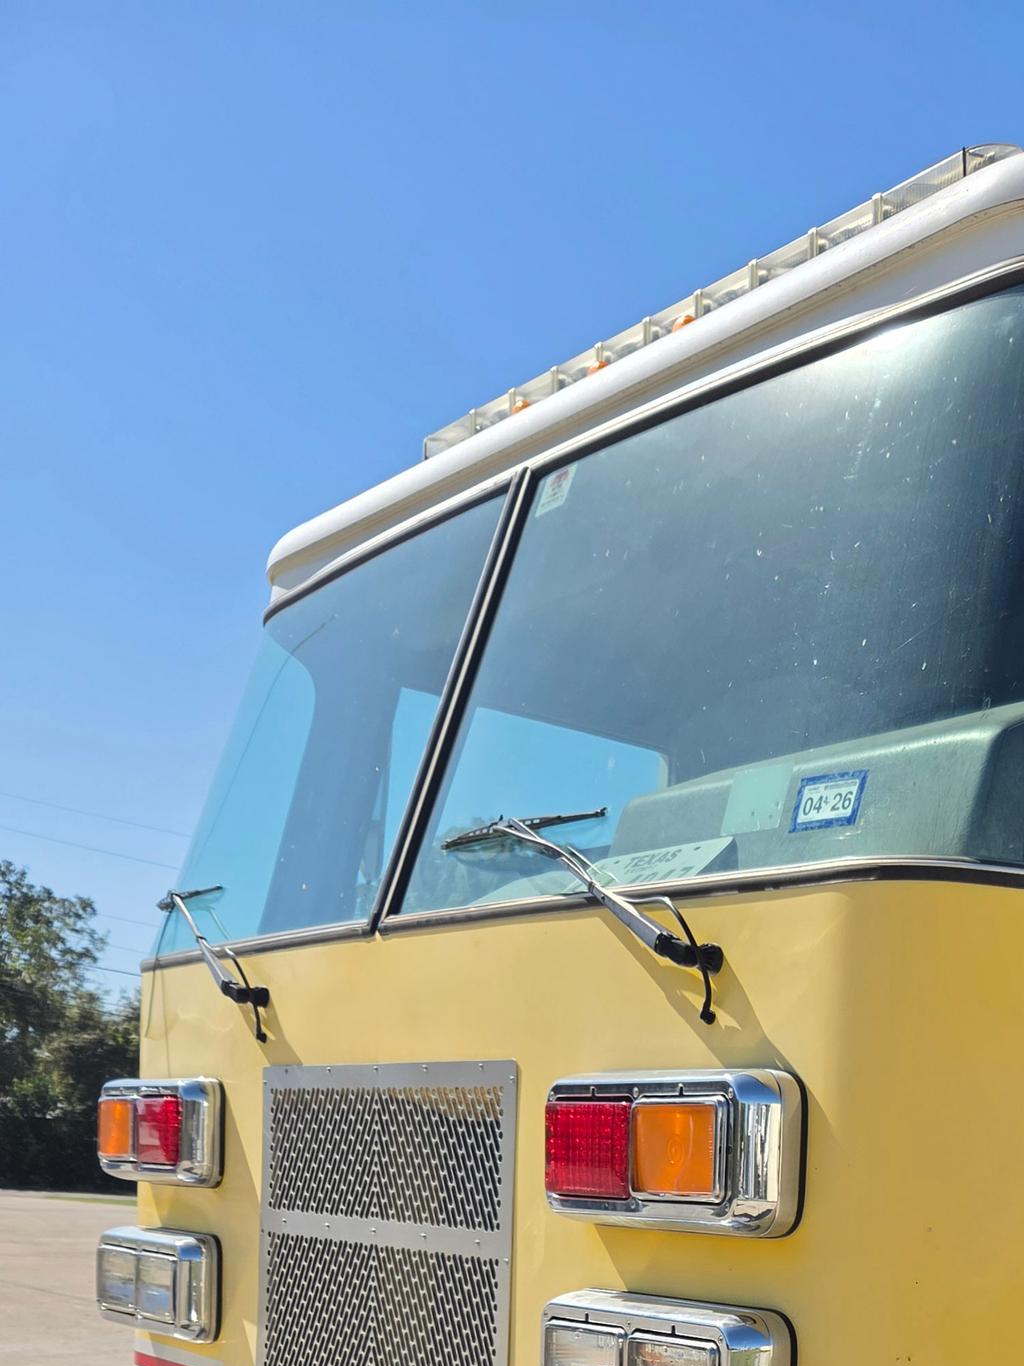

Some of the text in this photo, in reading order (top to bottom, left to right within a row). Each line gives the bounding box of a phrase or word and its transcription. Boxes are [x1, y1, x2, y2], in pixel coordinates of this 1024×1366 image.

[802, 790, 854, 816] 04 26
[624, 848, 682, 869] TEXAS
